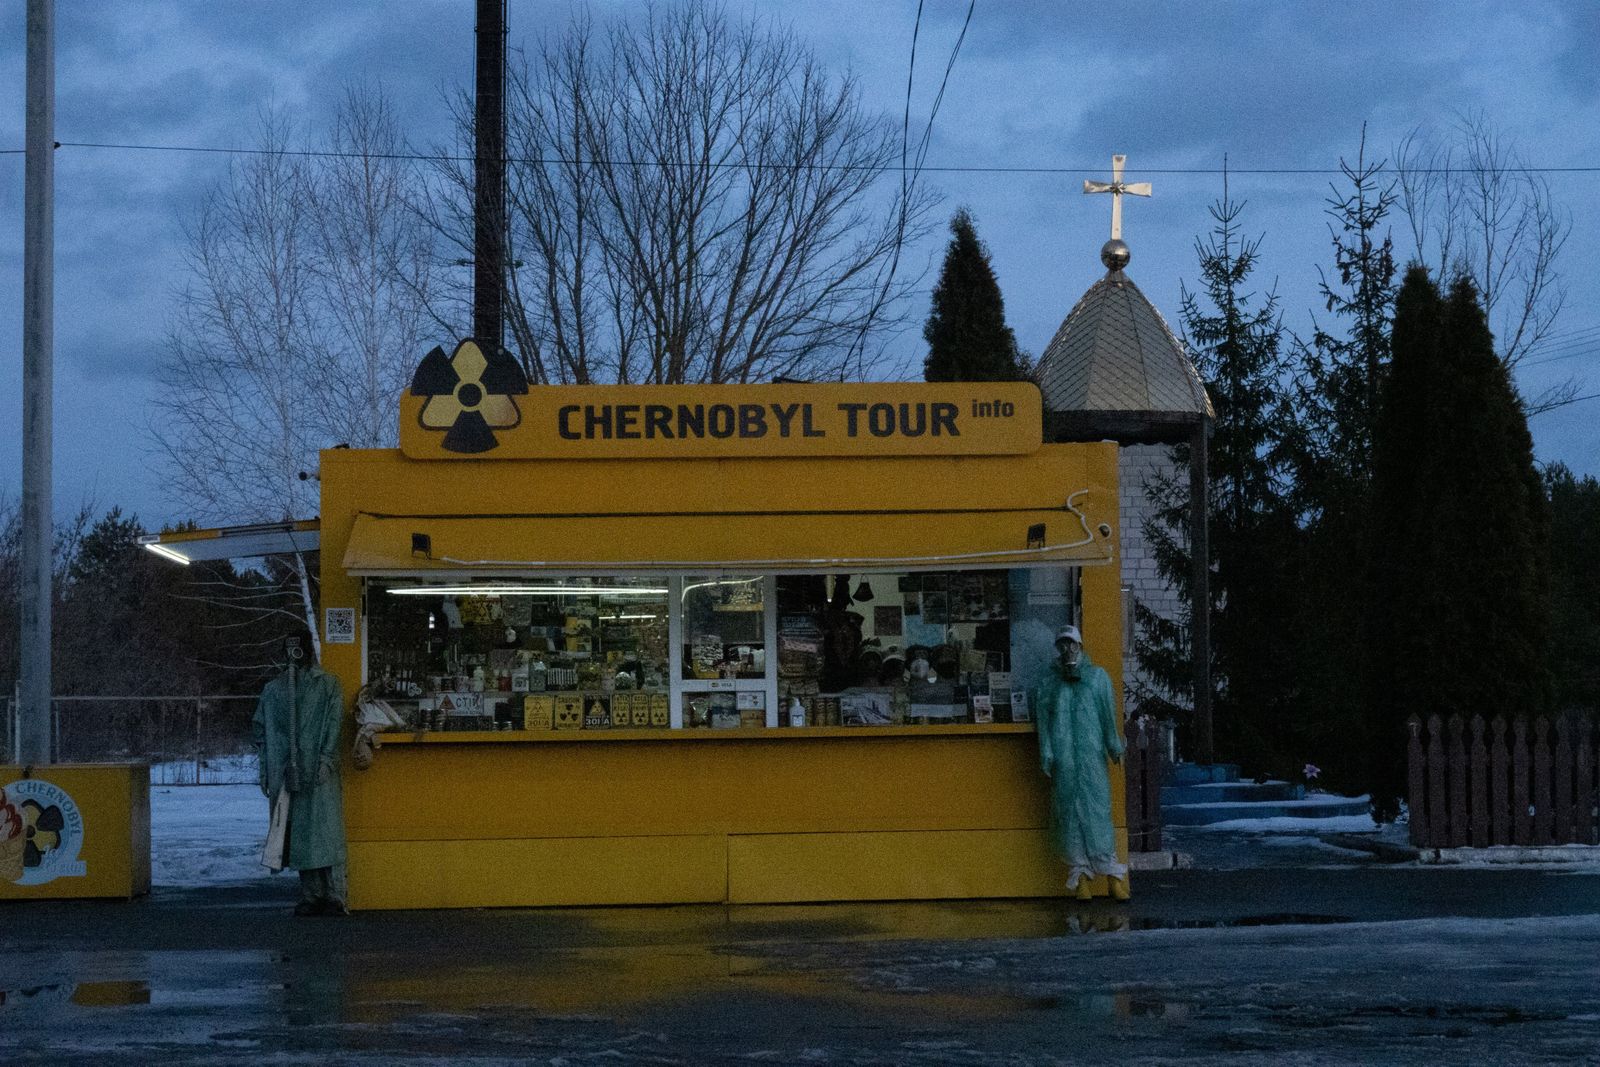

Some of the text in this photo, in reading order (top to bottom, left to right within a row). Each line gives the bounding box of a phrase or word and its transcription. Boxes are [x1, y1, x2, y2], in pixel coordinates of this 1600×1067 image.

[558, 398, 1015, 441] CHERNOBYL TOUR info
[15, 782, 82, 838] CHERNOBYL
